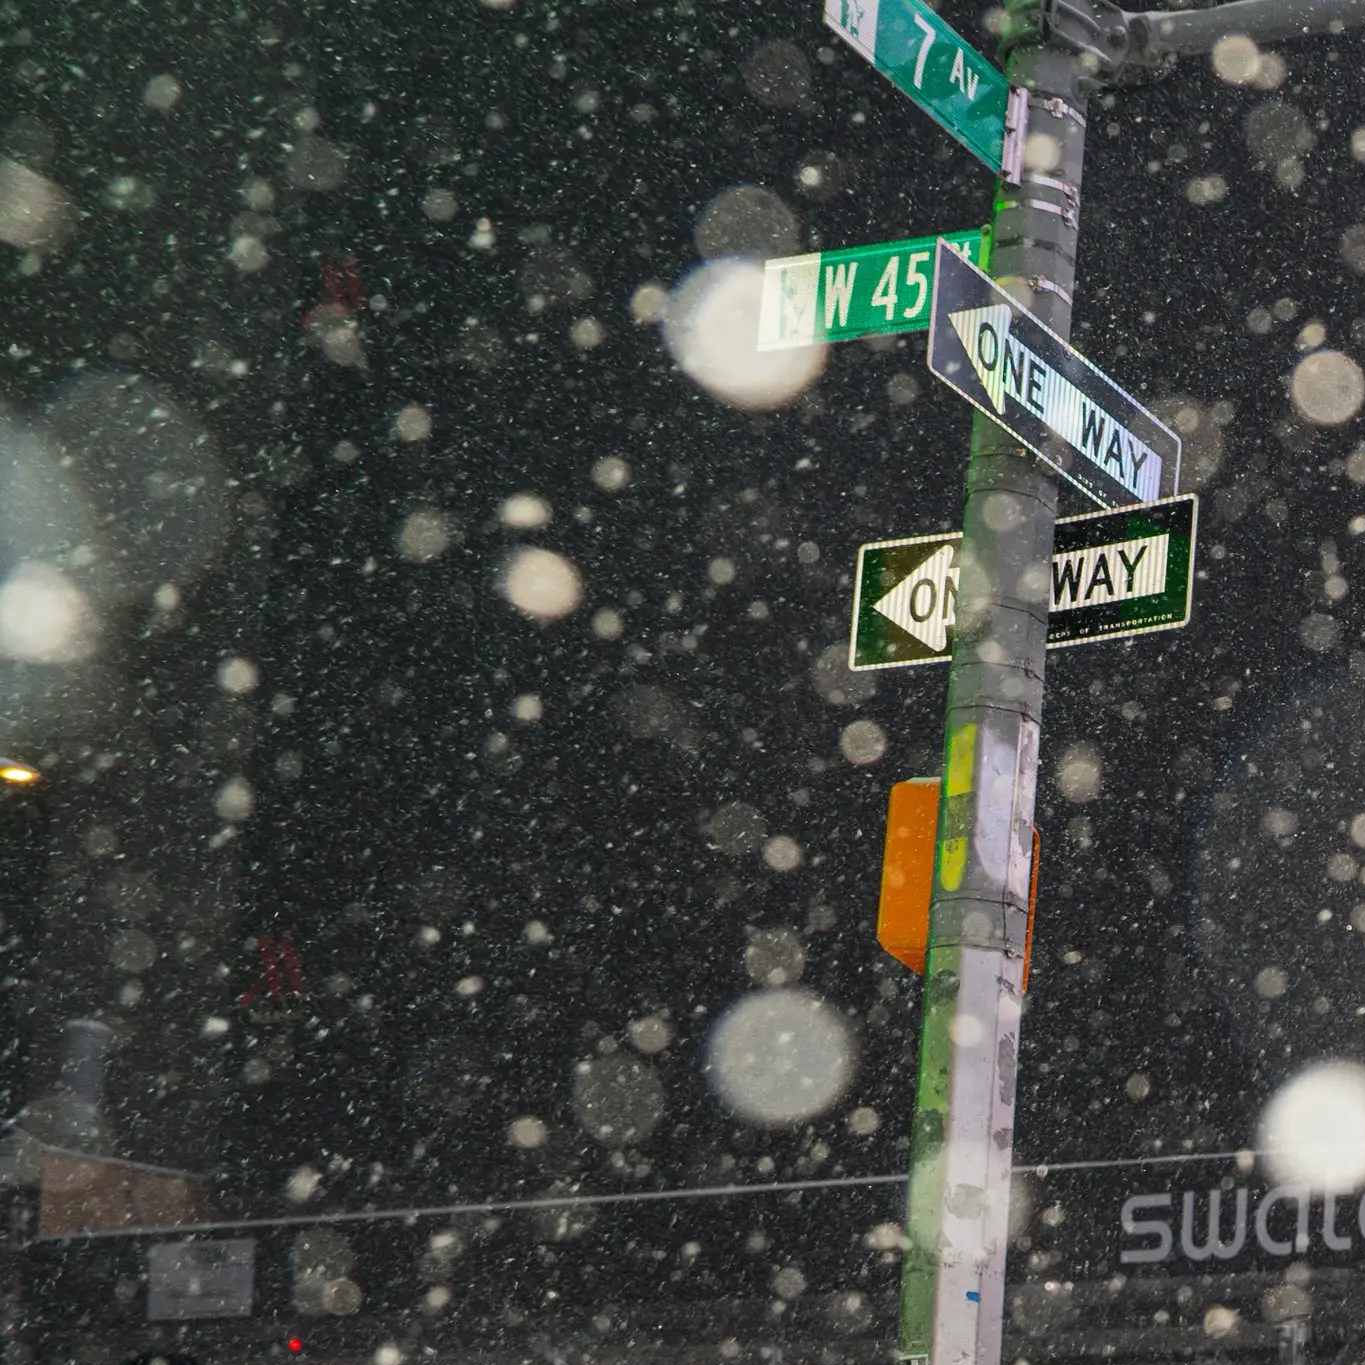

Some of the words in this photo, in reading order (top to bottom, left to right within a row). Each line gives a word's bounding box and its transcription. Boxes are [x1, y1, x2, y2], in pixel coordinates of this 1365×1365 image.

[913, 12, 937, 90] 7
[824, 261, 859, 330] W
[871, 251, 930, 320] 45
[977, 321, 1047, 413] ONE
[1080, 400, 1150, 492] WAY
[1051, 545, 1149, 606] WAY
[1099, 612, 1174, 632] TRANSPORTATION
